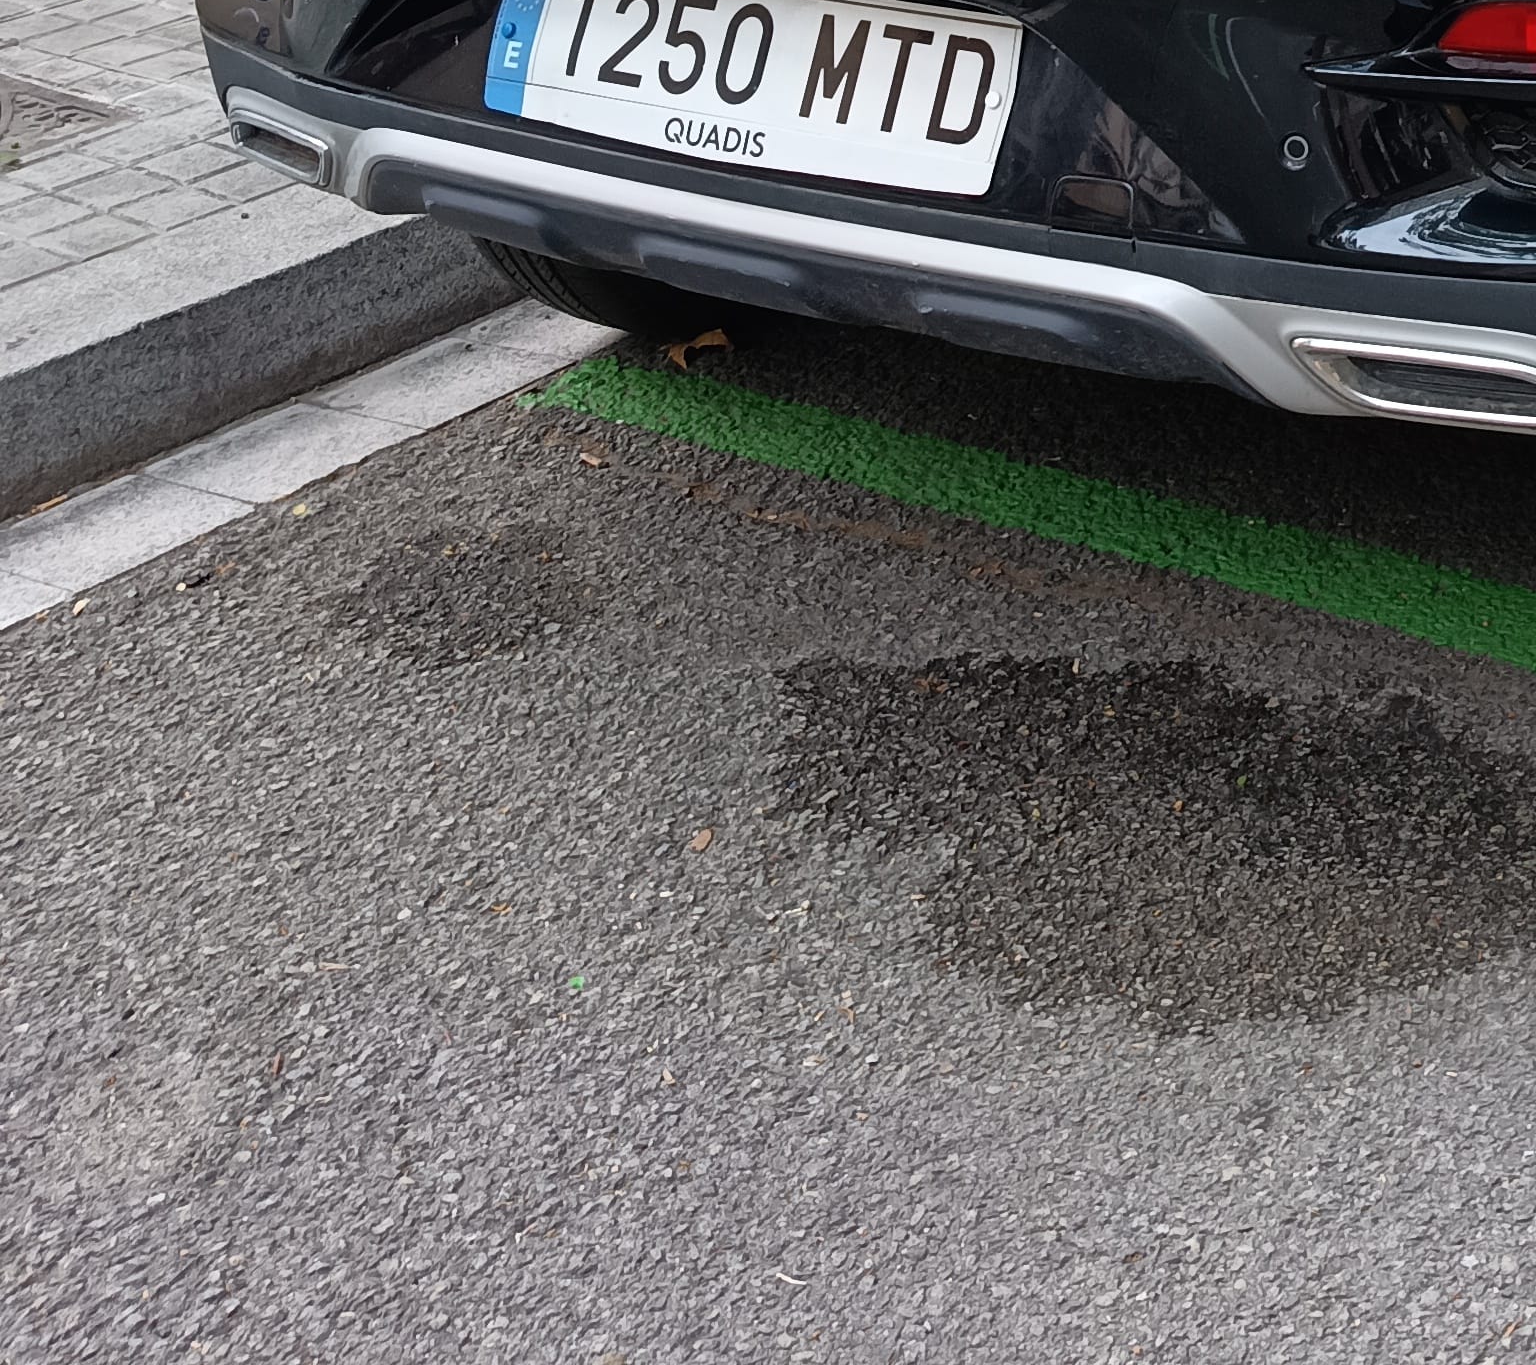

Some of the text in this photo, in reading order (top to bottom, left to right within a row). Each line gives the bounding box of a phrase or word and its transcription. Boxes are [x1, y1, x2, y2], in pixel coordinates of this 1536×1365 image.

[503, 41, 522, 69] E
[799, 14, 996, 145] MTD
[664, 117, 766, 158] QUADIS
